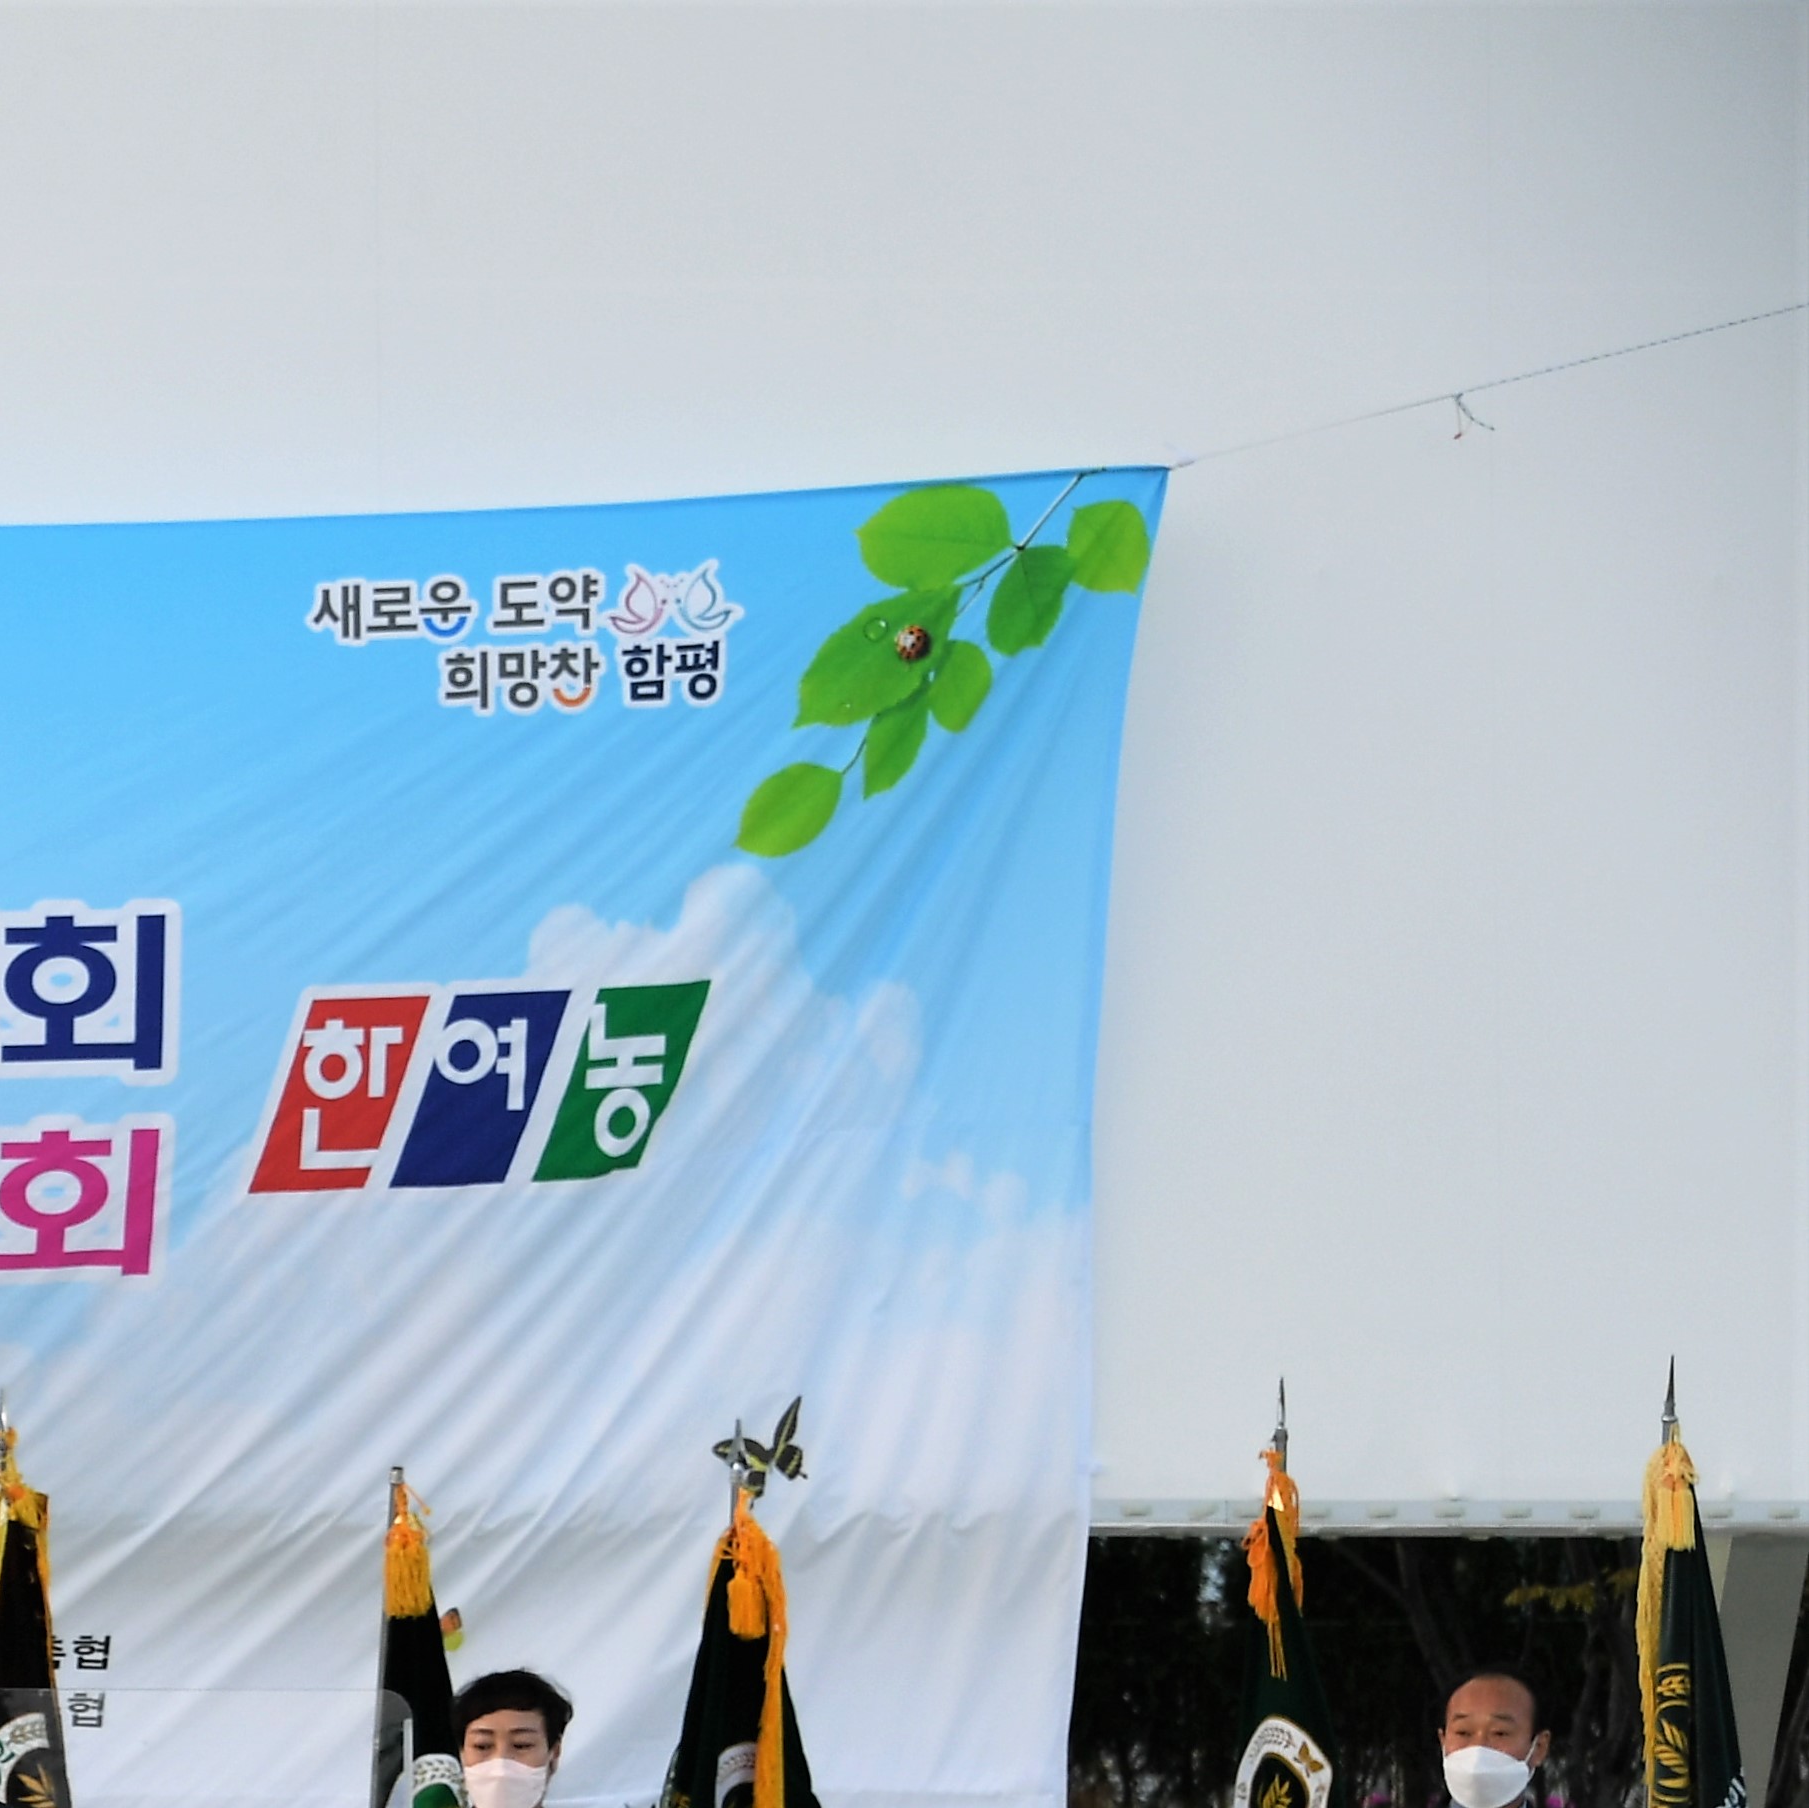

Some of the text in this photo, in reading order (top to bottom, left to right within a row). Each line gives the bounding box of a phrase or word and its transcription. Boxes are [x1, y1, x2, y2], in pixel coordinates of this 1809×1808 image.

[312, 575, 599, 641] 새로운 도약
[621, 640, 720, 702] 함평
[272, 992, 682, 1182] 한여농
